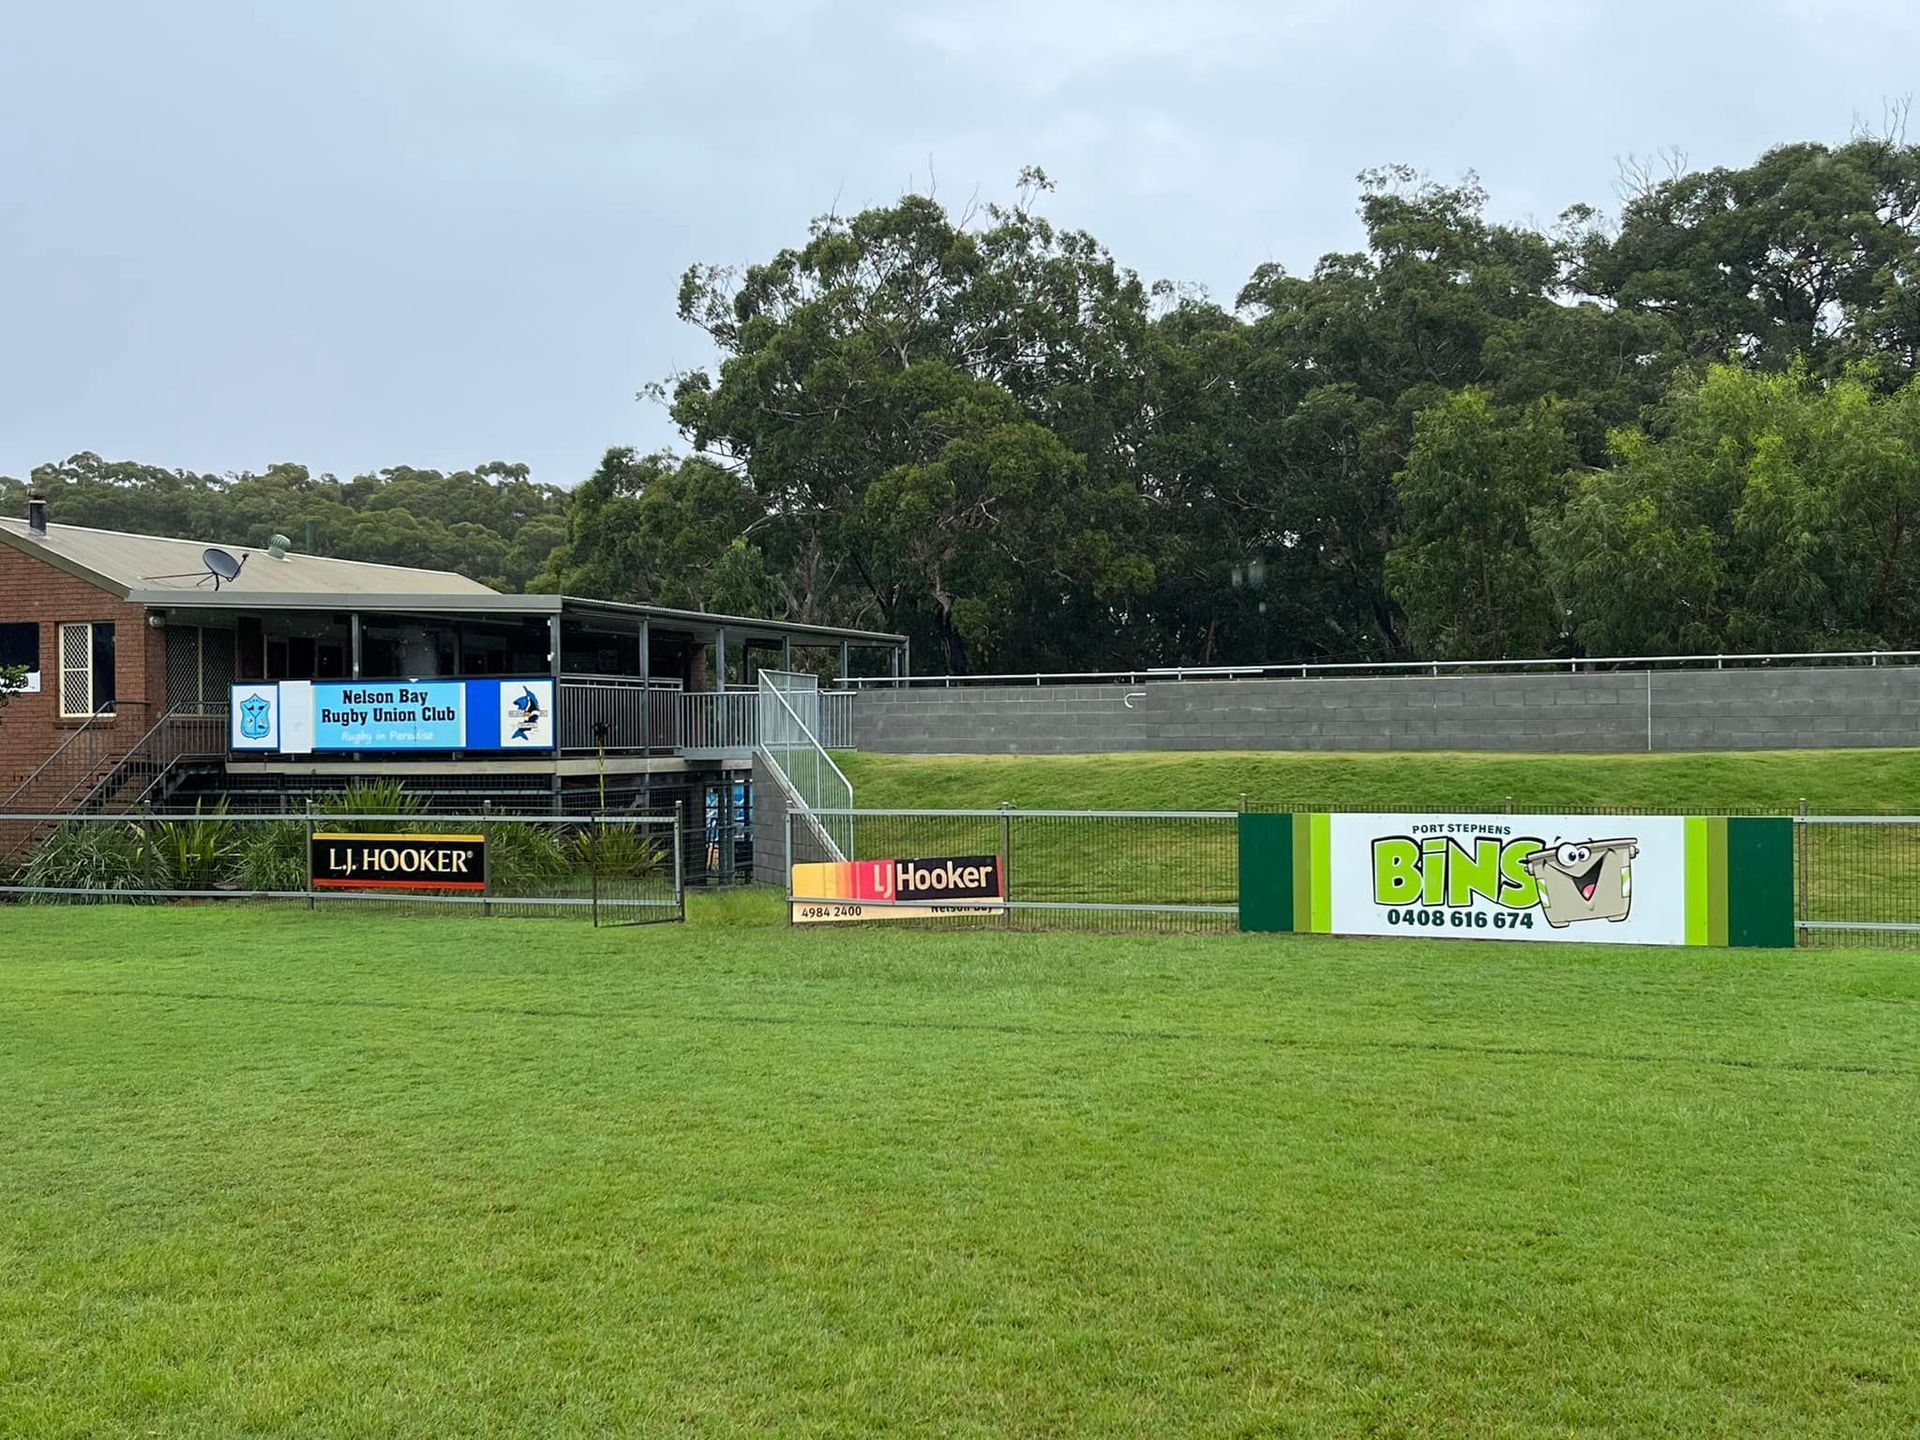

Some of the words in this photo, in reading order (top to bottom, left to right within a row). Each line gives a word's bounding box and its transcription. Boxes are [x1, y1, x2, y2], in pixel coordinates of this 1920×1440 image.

[342, 690, 394, 704] Nelson
[399, 688, 428, 706] Bay
[321, 708, 368, 726] Rugby
[373, 707, 416, 722] Union
[422, 706, 455, 721] Club
[341, 731, 372, 744] Rugby
[376, 732, 386, 740] in
[1412, 823, 1445, 834] PORT
[1447, 823, 1511, 835] STEPHENS
[329, 848, 357, 875] L.J.
[897, 861, 993, 891] Hooker
[801, 908, 830, 918] 4984
[834, 906, 862, 917] 2400
[1387, 909, 1445, 926] 0408
[1450, 911, 1488, 927] 616
[1493, 912, 1533, 928] 674
